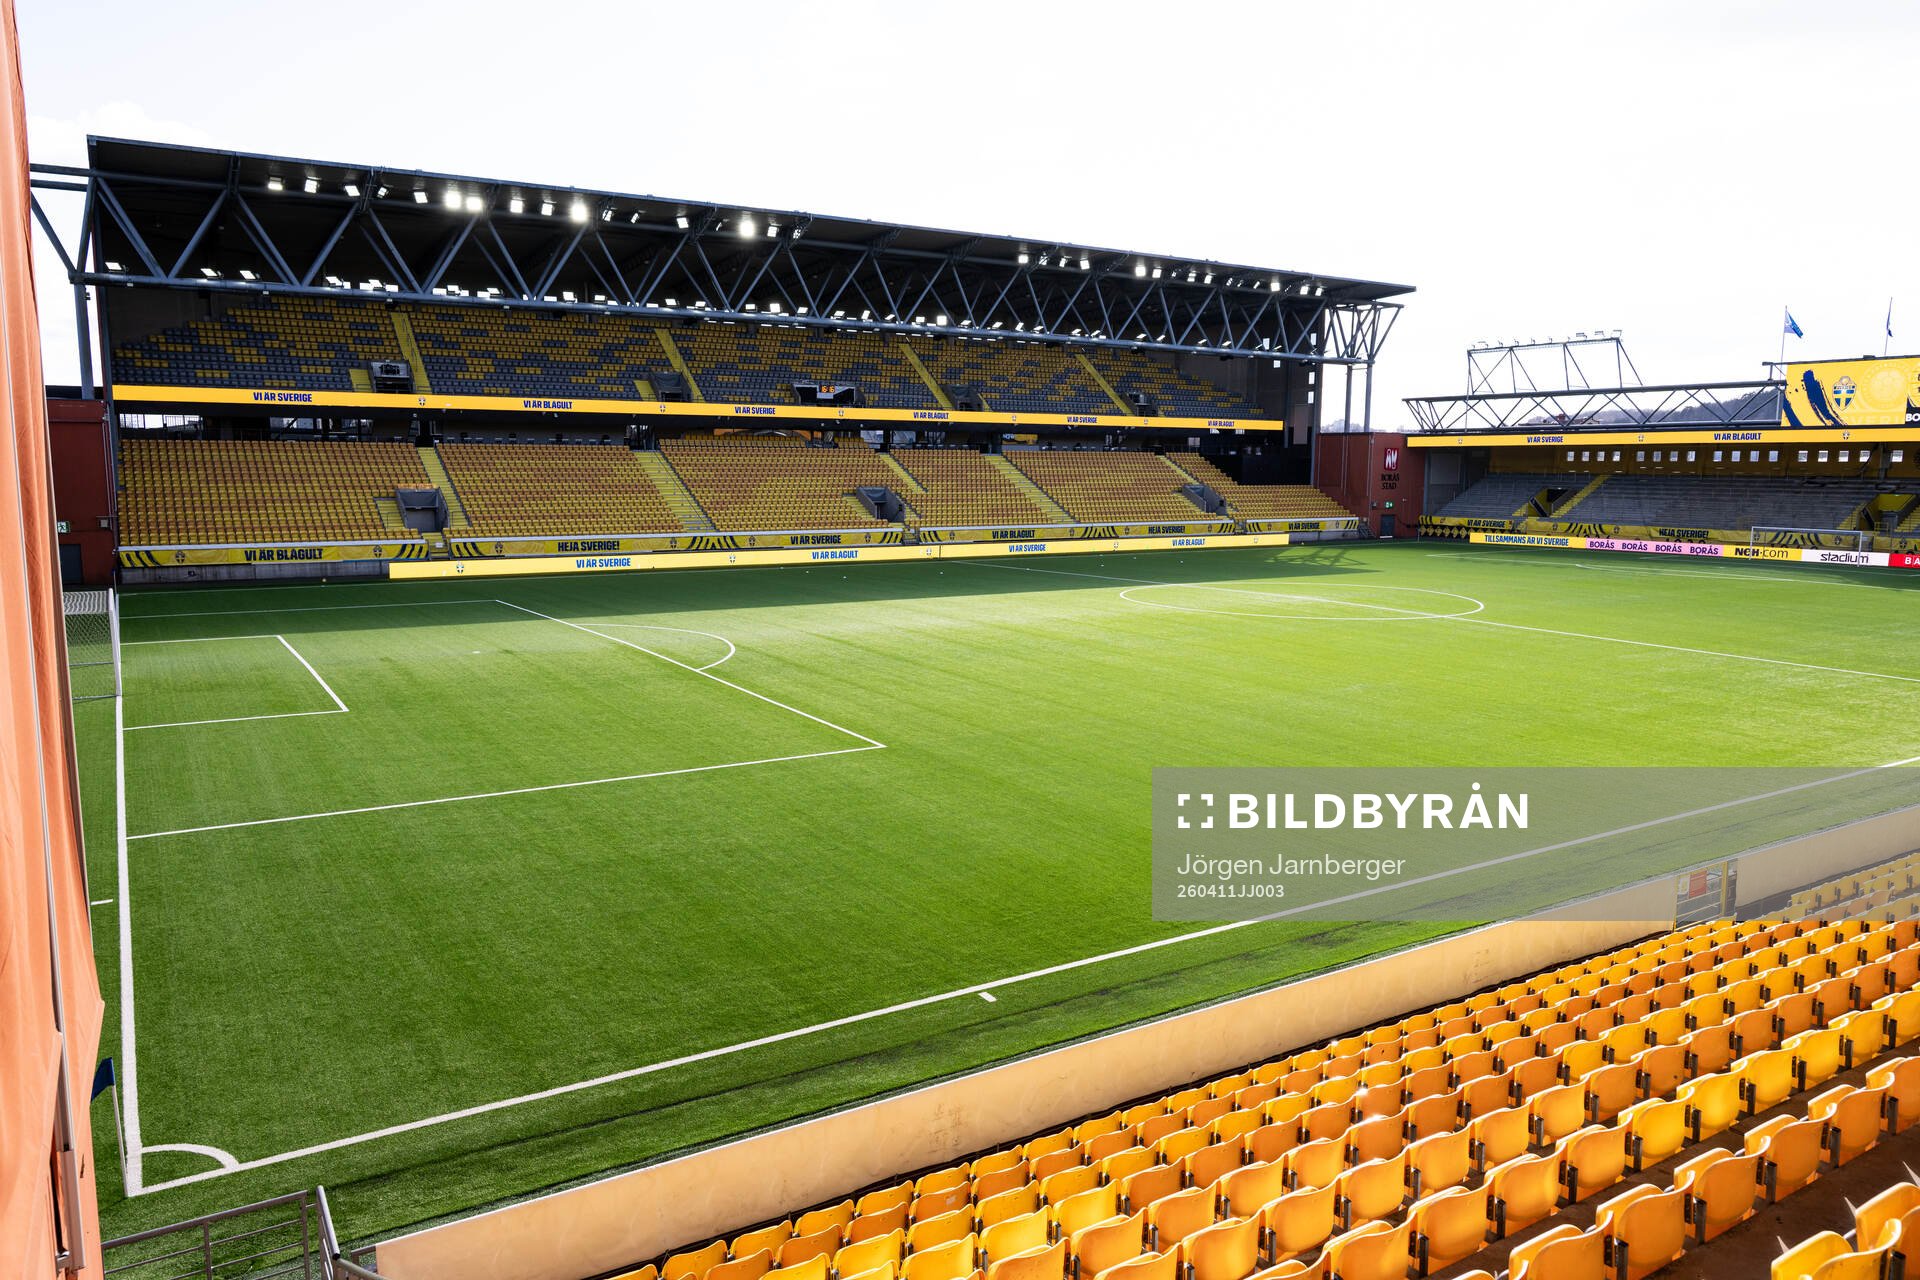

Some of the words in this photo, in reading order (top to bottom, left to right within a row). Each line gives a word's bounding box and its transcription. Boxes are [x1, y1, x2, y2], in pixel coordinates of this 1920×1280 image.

[253, 392, 262, 400] VI
[277, 393, 312, 402] SVERIGE
[524, 400, 531, 408] VI
[1482, 520, 1506, 528] SVERIGE
[992, 531, 999, 539] VI
[1659, 528, 1675, 537] HEJA
[1676, 529, 1709, 538] SVERIGE!
[791, 536, 798, 544] VI
[811, 535, 841, 544] SVERIGE
[1485, 535, 1527, 544] TILLSAMMANS
[1544, 538, 1569, 546] SVERIGE
[1589, 540, 1615, 549] BORÅS
[558, 542, 579, 552] HEJA
[581, 541, 619, 551] SVERIGE!
[1024, 544, 1046, 552] SVERIGE
[1622, 542, 1648, 551] BORÅS
[1655, 543, 1682, 553] BORÅS
[1690, 544, 1719, 555] BORÅS
[245, 550, 256, 561] VI
[1820, 552, 1869, 564] stadium
[576, 560, 584, 568] VI
[599, 558, 631, 567] SVERIGE
